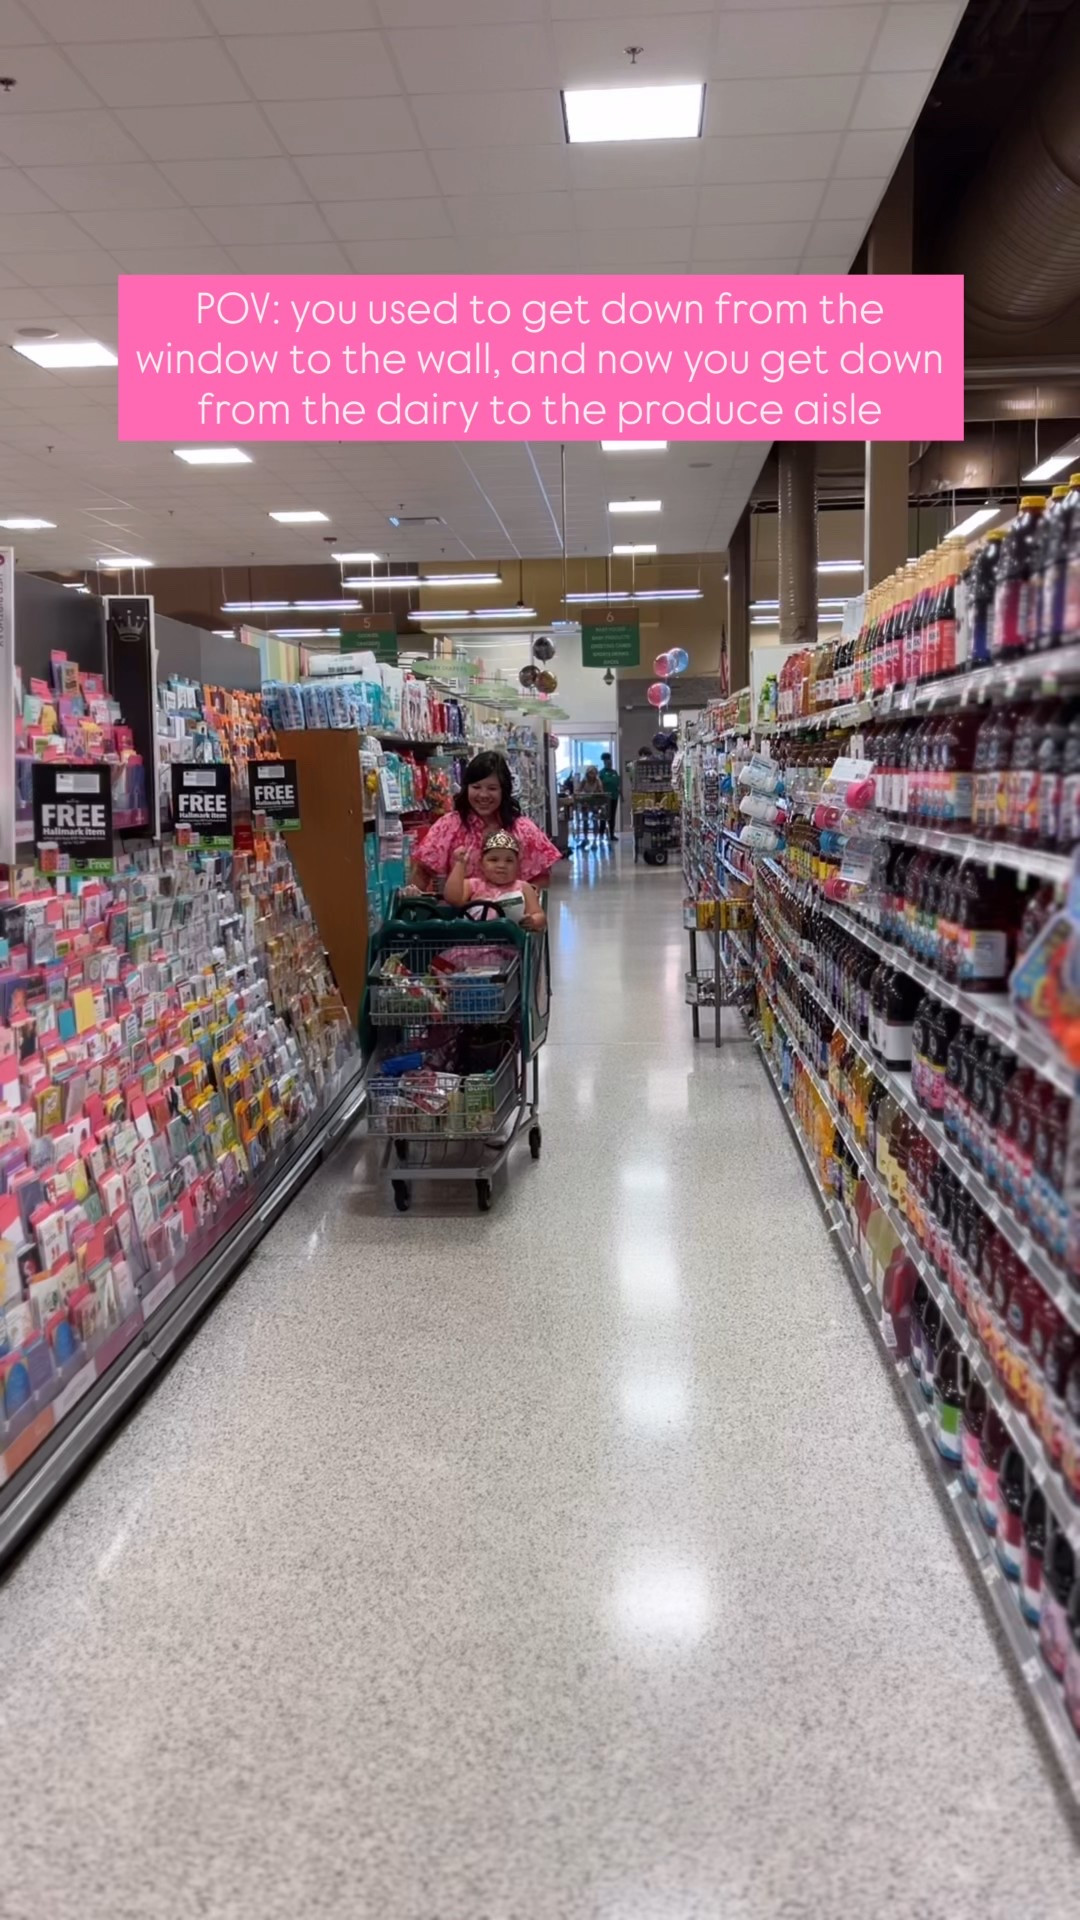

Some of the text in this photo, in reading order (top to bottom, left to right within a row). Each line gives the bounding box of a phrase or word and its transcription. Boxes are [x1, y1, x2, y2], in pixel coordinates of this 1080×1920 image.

[606, 611, 614, 622] 6
[363, 617, 371, 629] 5
[254, 785, 295, 800] FREE
[178, 794, 227, 812] FREE
[41, 804, 106, 827] FREE
[43, 827, 106, 836] Hallmark item
[88, 858, 111, 869] Free
